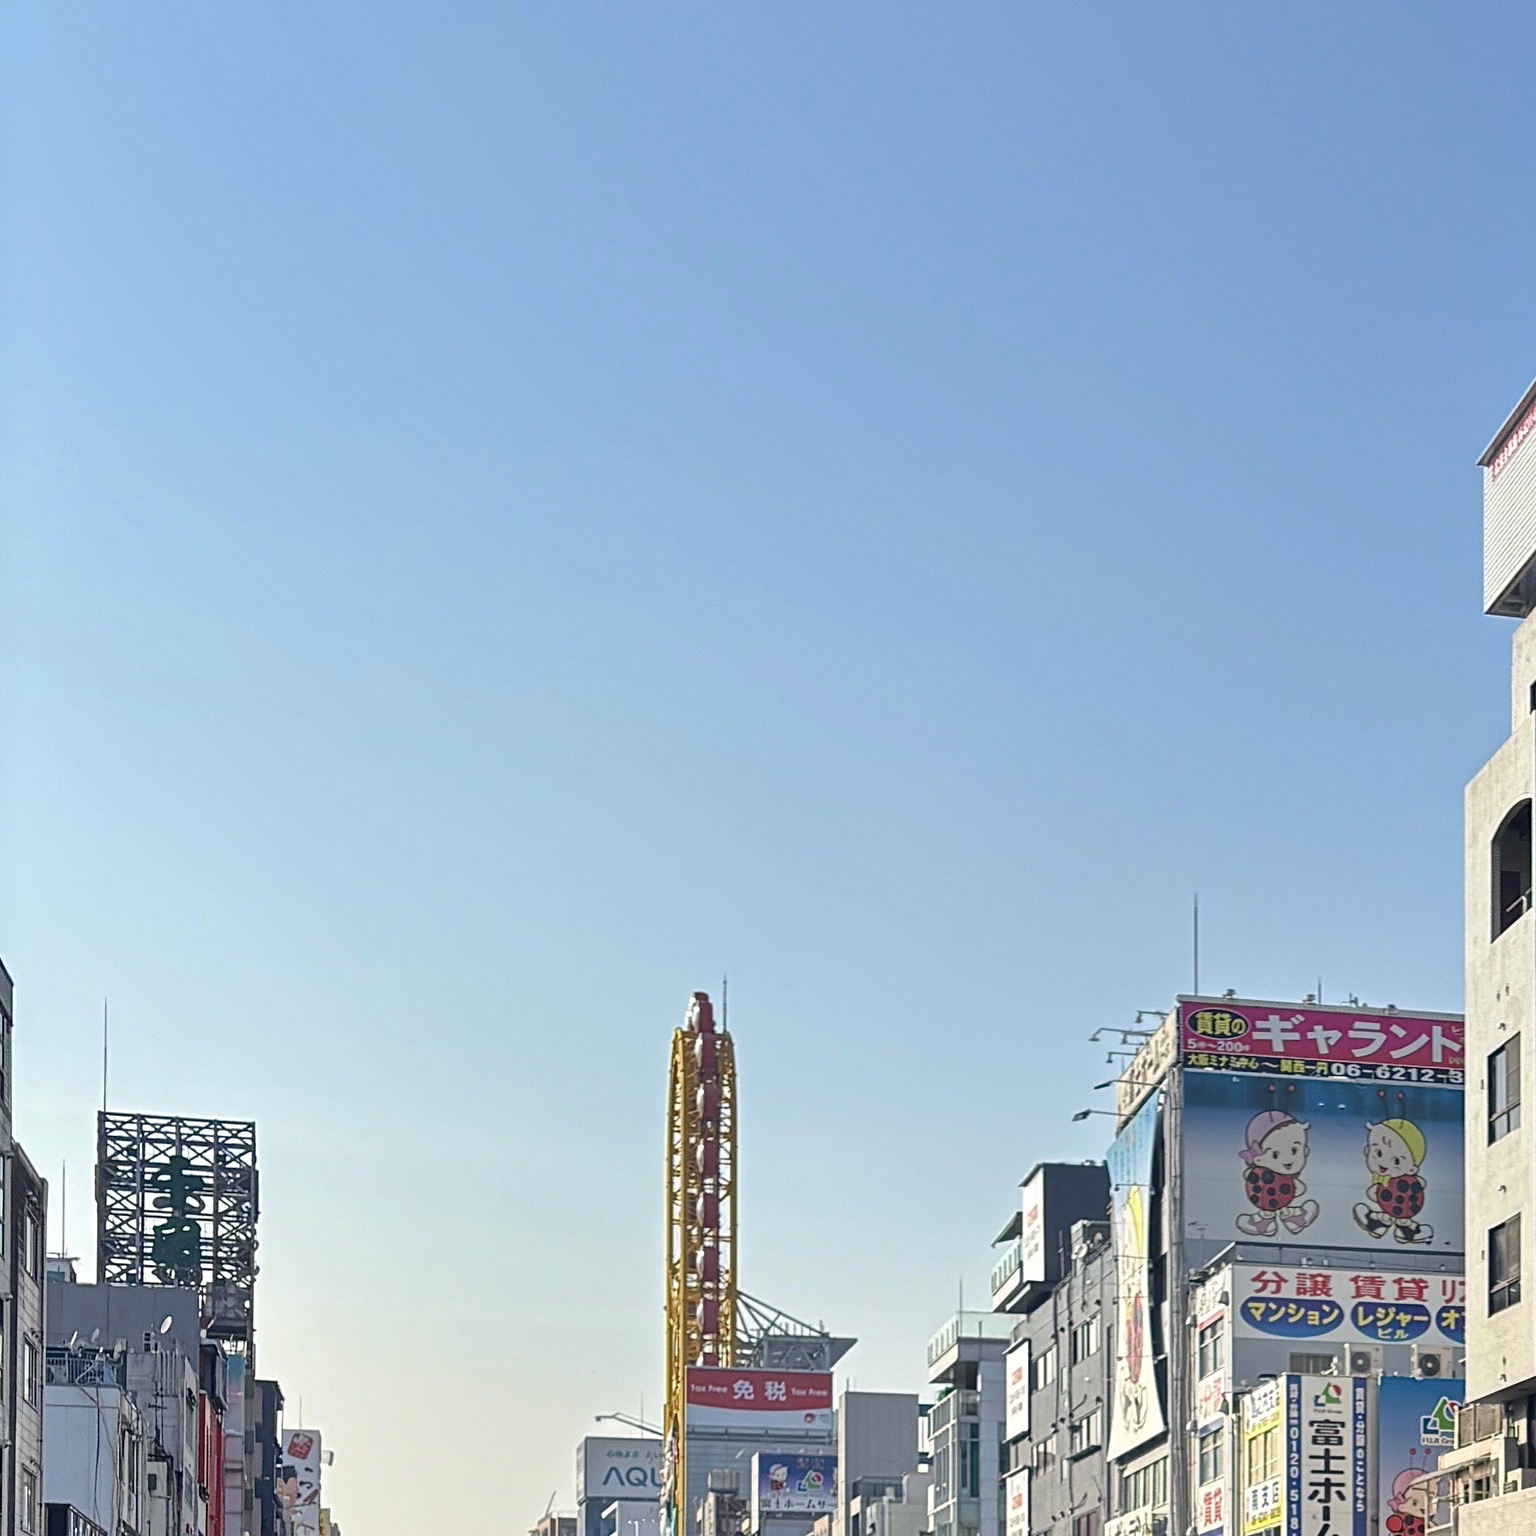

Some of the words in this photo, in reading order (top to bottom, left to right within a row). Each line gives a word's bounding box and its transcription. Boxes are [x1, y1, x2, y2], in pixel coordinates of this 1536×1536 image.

[1196, 1012, 1246, 1036] 賃貸の
[1252, 1015, 1461, 1063] ギャラント
[1250, 1270, 1333, 1298] 分譲
[1350, 1274, 1429, 1302] 賃貸
[1247, 1302, 1341, 1326] マンション
[1357, 1307, 1429, 1328] レジャー
[1377, 1328, 1408, 1340] ビル
[733, 1380, 787, 1402] 免税
